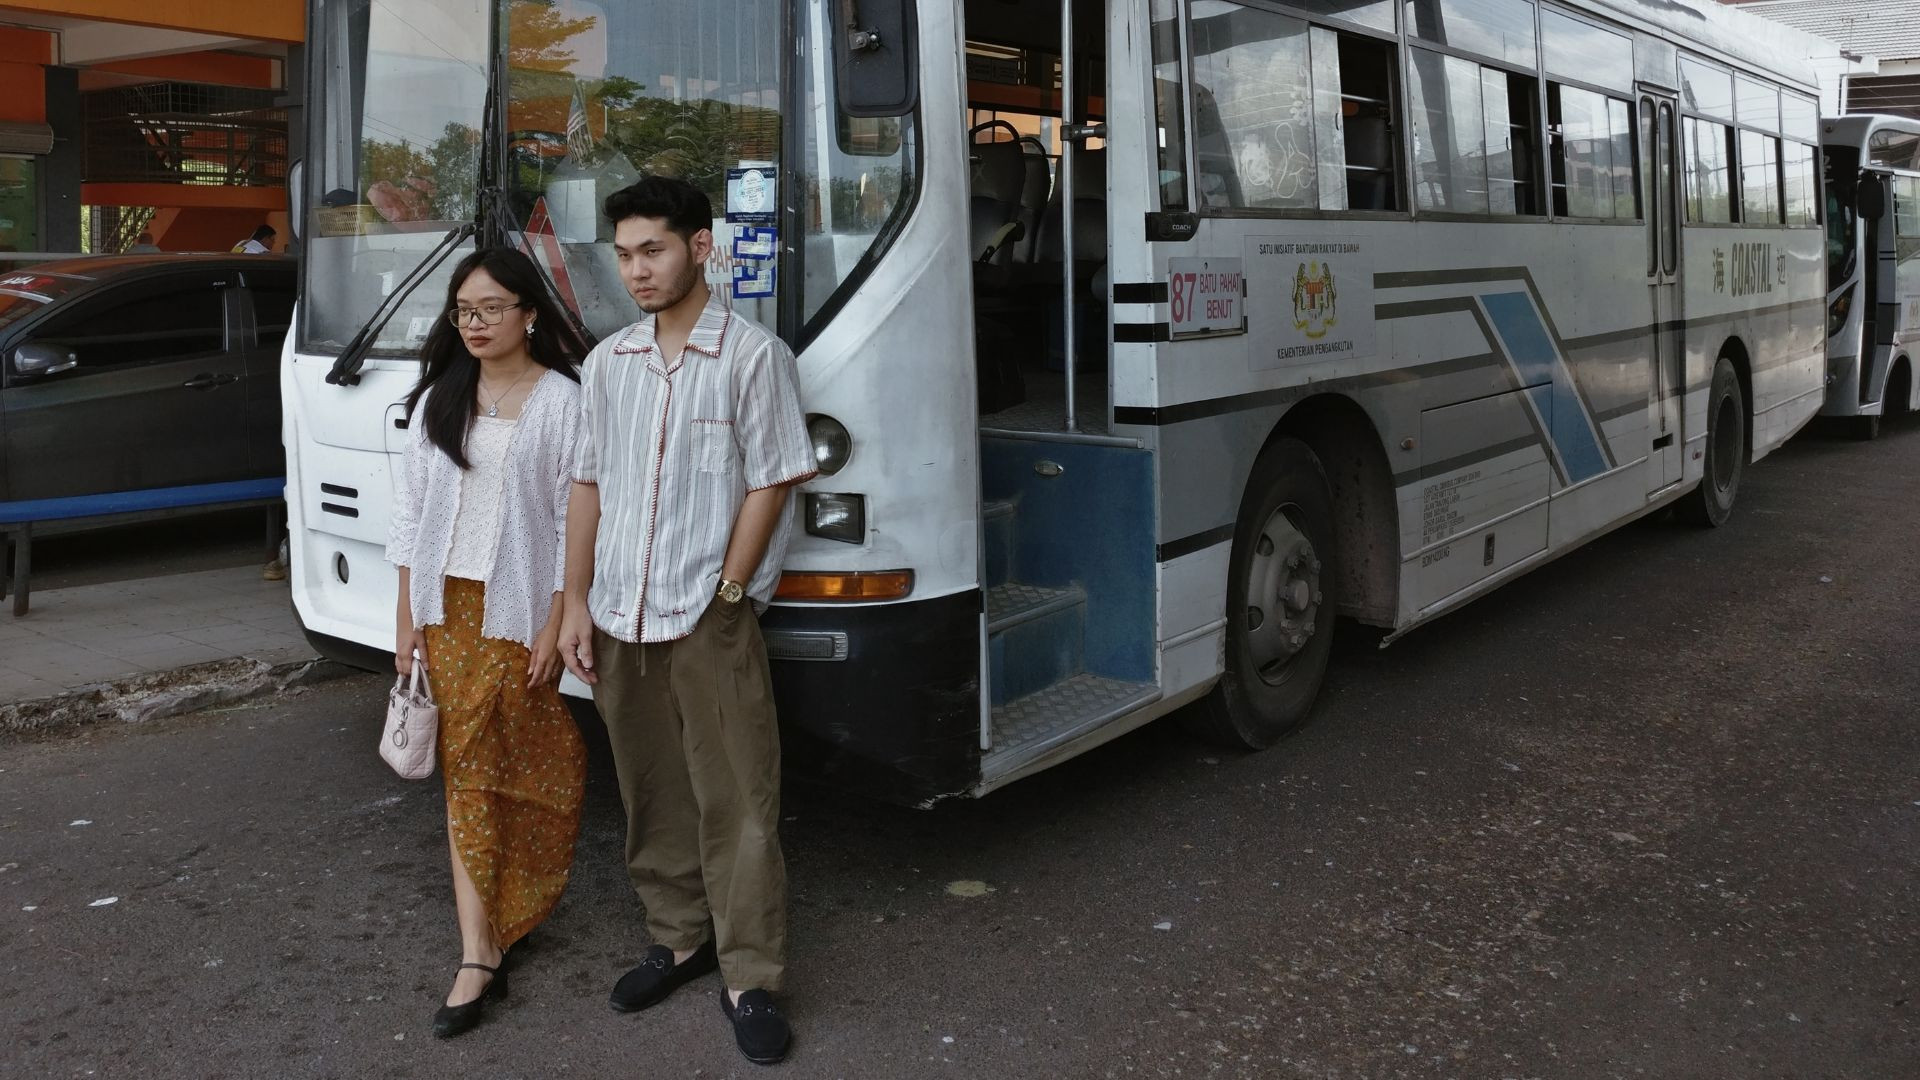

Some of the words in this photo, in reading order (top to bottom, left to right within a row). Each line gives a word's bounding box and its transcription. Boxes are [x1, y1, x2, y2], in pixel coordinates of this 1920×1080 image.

[1259, 244, 1273, 255] SATU
[1295, 244, 1318, 254] BANTUAN
[1319, 244, 1337, 254] RAKYAT
[1343, 244, 1360, 254] BAWAH
[1731, 242, 1772, 298] COASTAL
[1199, 273, 1217, 294] BATU
[1219, 272, 1240, 293] PAHAT
[1172, 272, 1197, 323] 87
[1206, 298, 1233, 320] BENUT
[1277, 345, 1314, 360] KEMENTERIAN
[1315, 341, 1353, 355] PENGANGKUTAN
